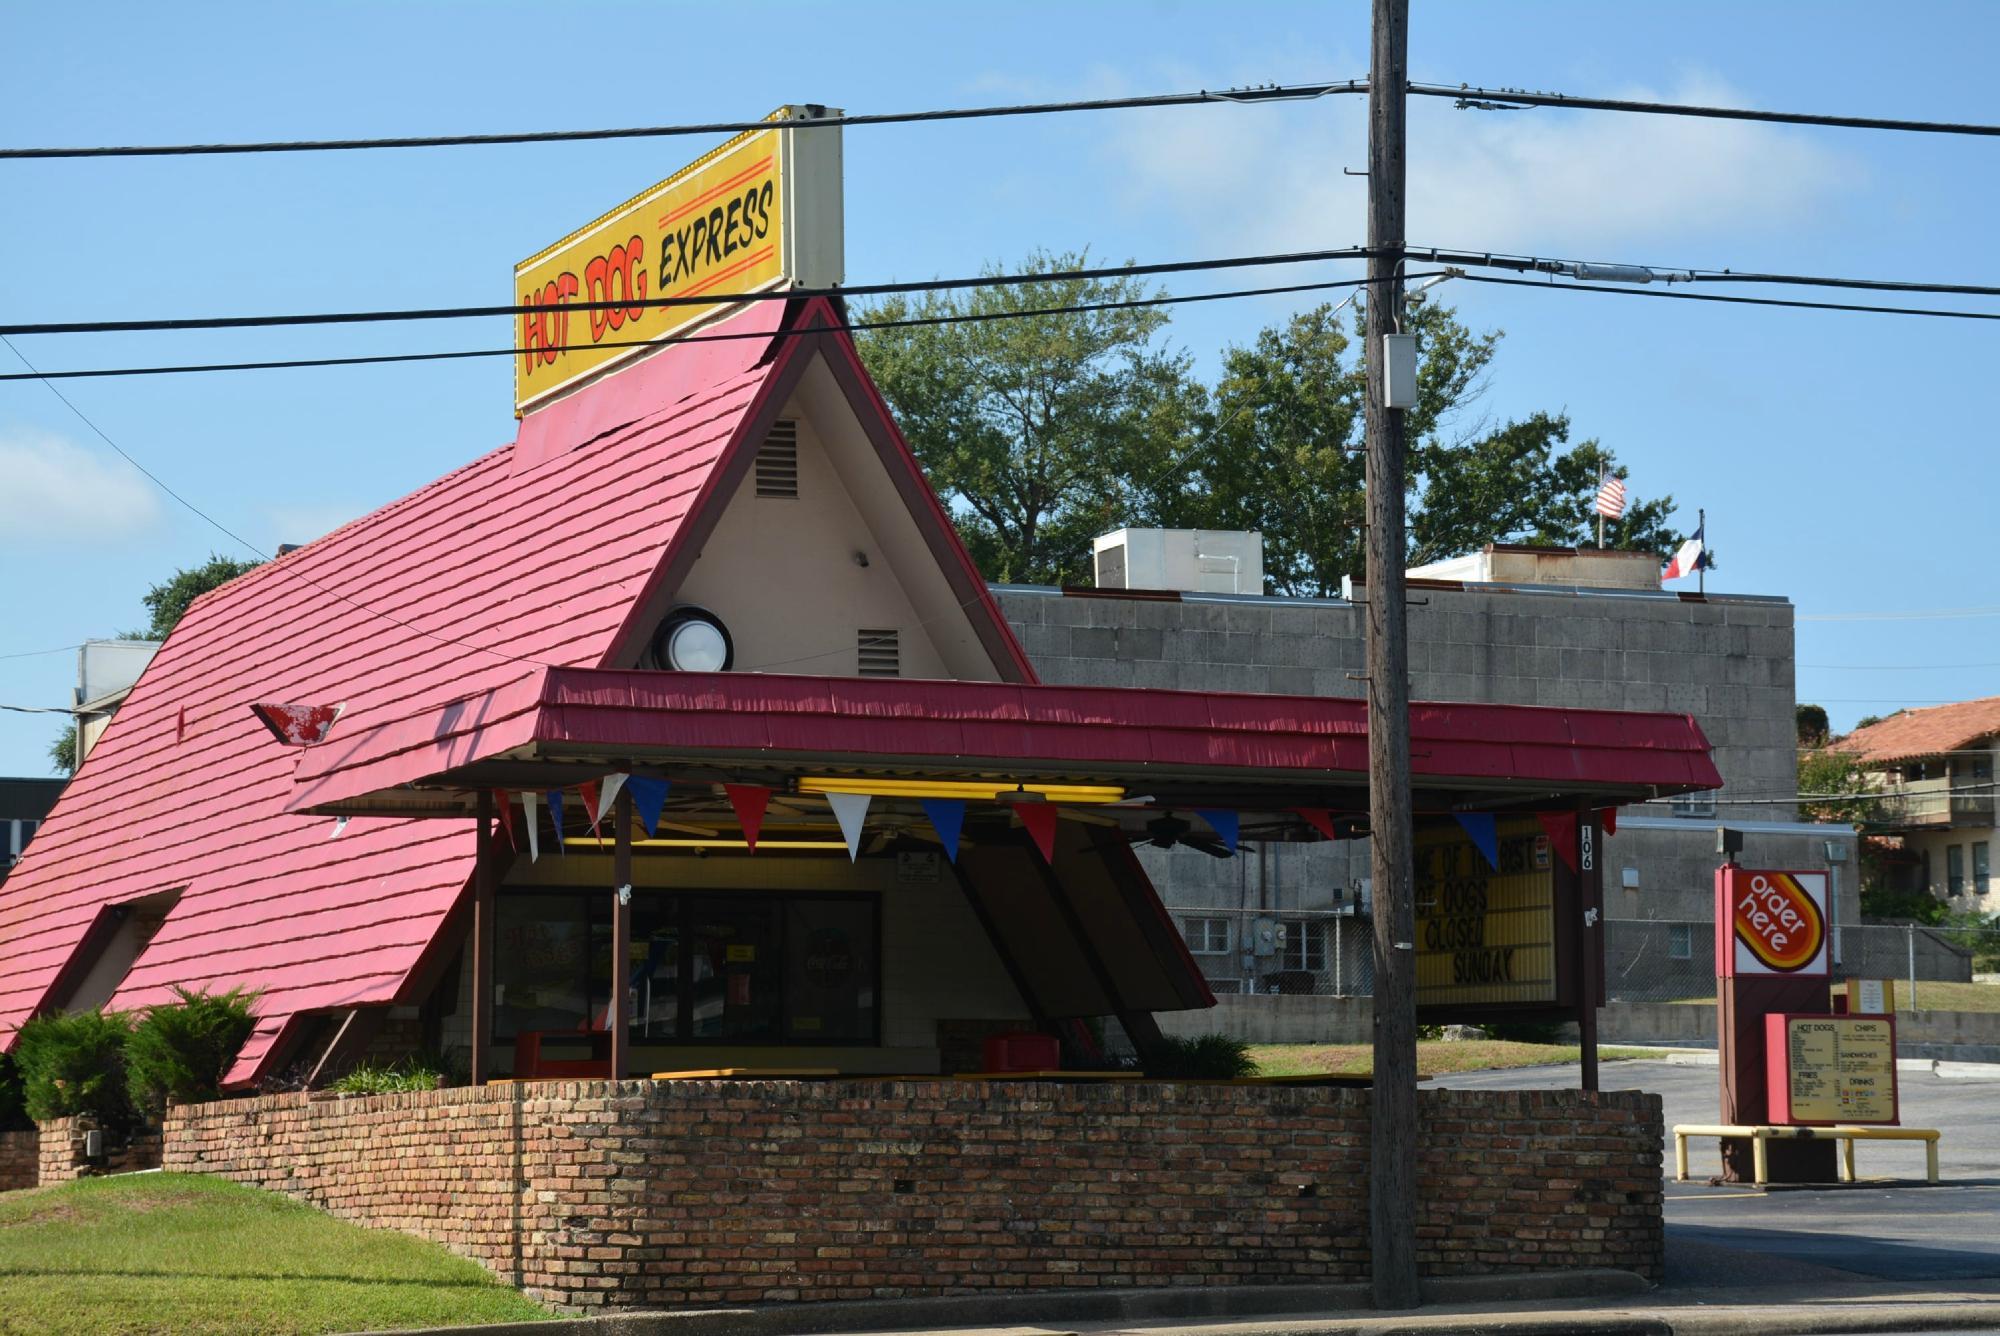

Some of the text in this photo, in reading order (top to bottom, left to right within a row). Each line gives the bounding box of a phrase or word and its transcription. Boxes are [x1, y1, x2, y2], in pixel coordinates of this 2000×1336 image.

[523, 179, 774, 377] HOT DOG EXPRESS
[1582, 826, 1592, 869] 106
[1750, 875, 1806, 934] order
[1426, 916, 1484, 950] CLOSED
[1738, 893, 1788, 952] here
[1454, 948, 1514, 982] SUNDAY
[1814, 1023, 1835, 1032] DOGS
[1854, 1024, 1877, 1032] CHIPS
[1849, 1078, 1875, 1086] DRINKS
